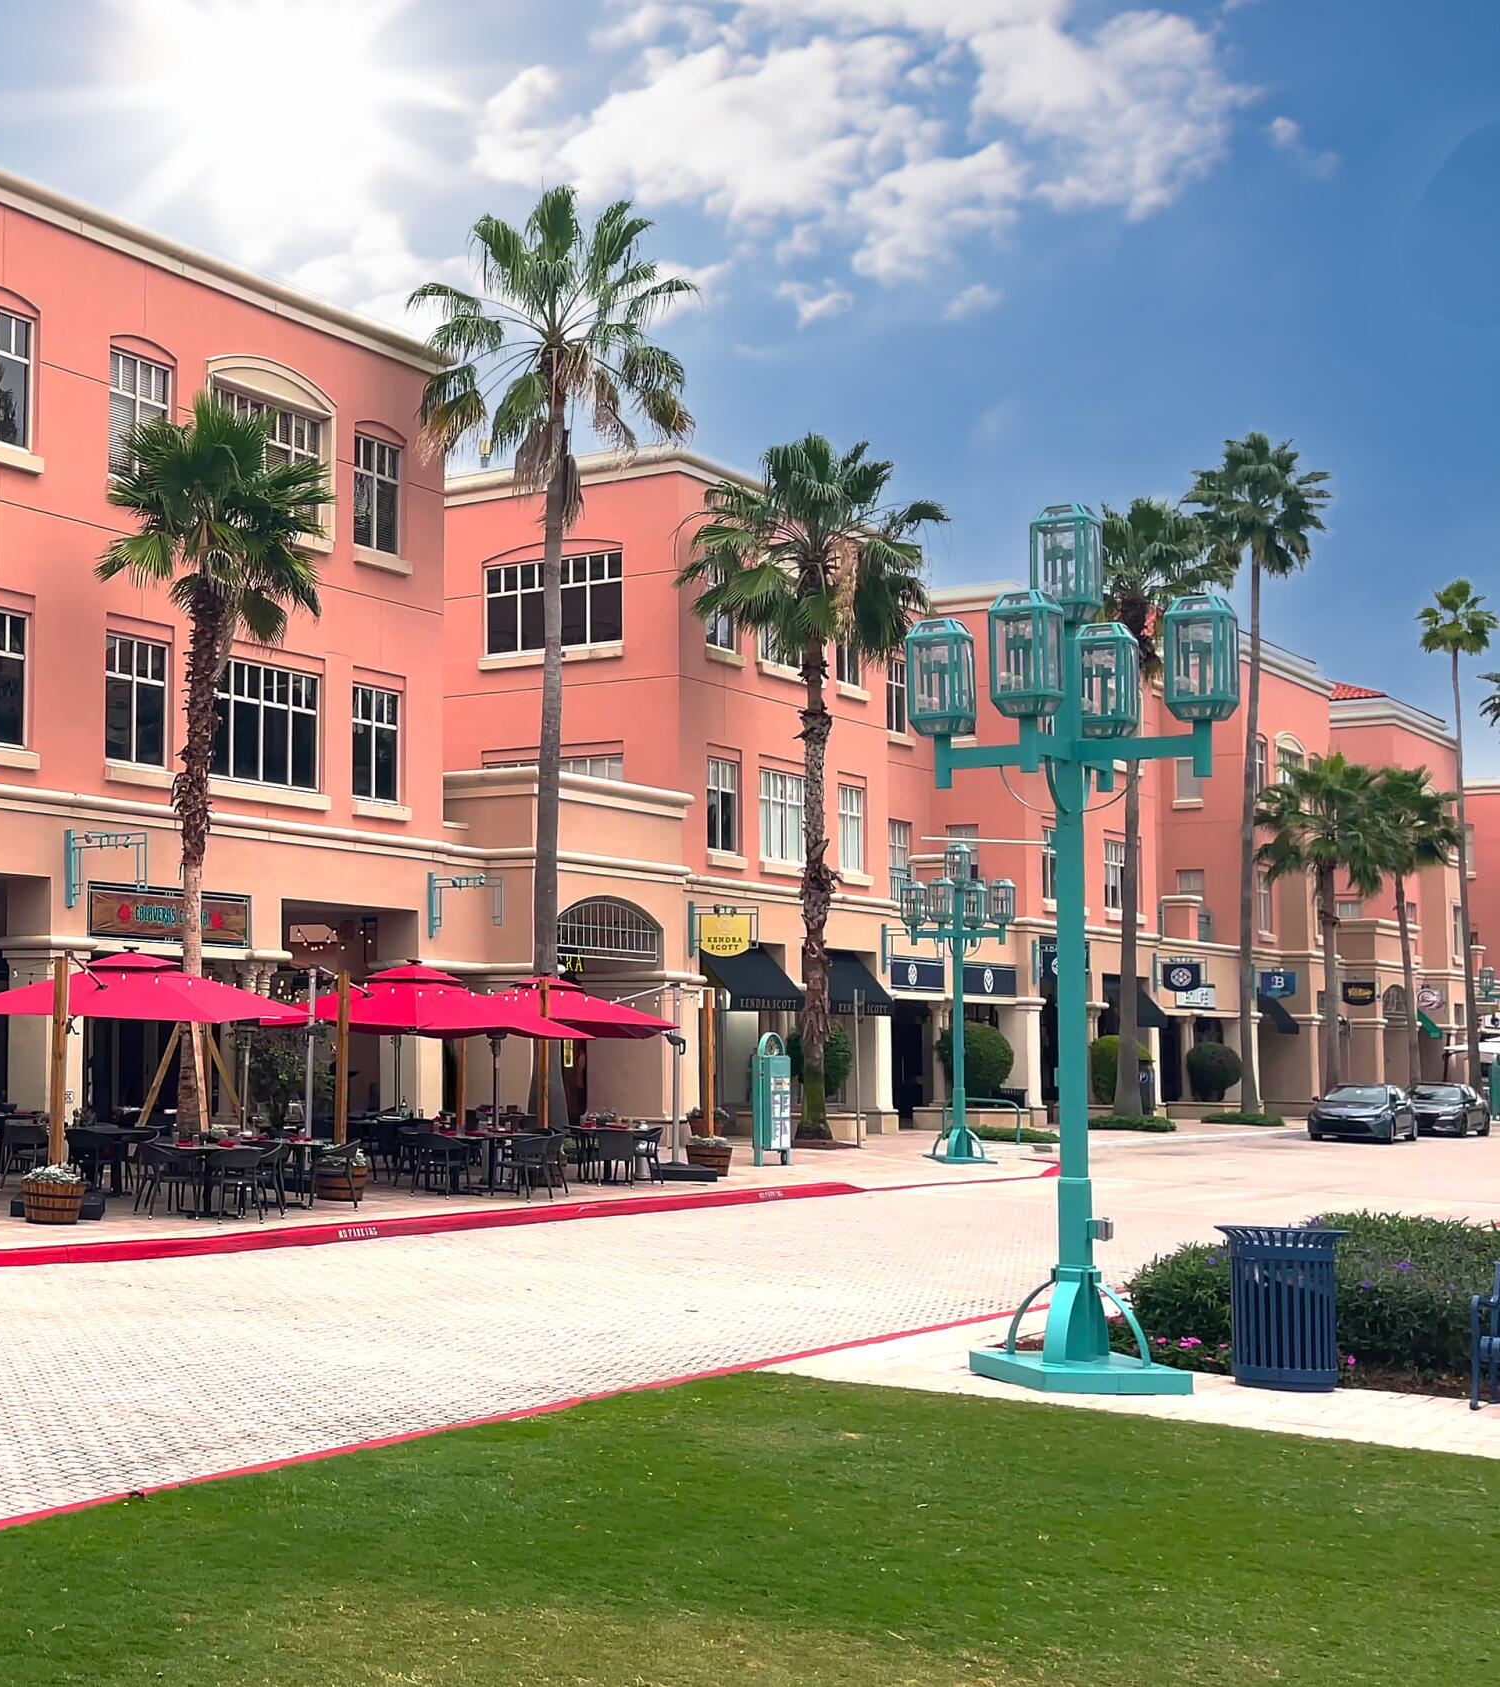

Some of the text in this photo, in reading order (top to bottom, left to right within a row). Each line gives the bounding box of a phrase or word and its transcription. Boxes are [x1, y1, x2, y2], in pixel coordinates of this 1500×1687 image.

[135, 905, 176, 925] CALAVERAS
[740, 998, 797, 1010] KENDRA SCOTT
[866, 1004, 888, 1015] SCOTT
